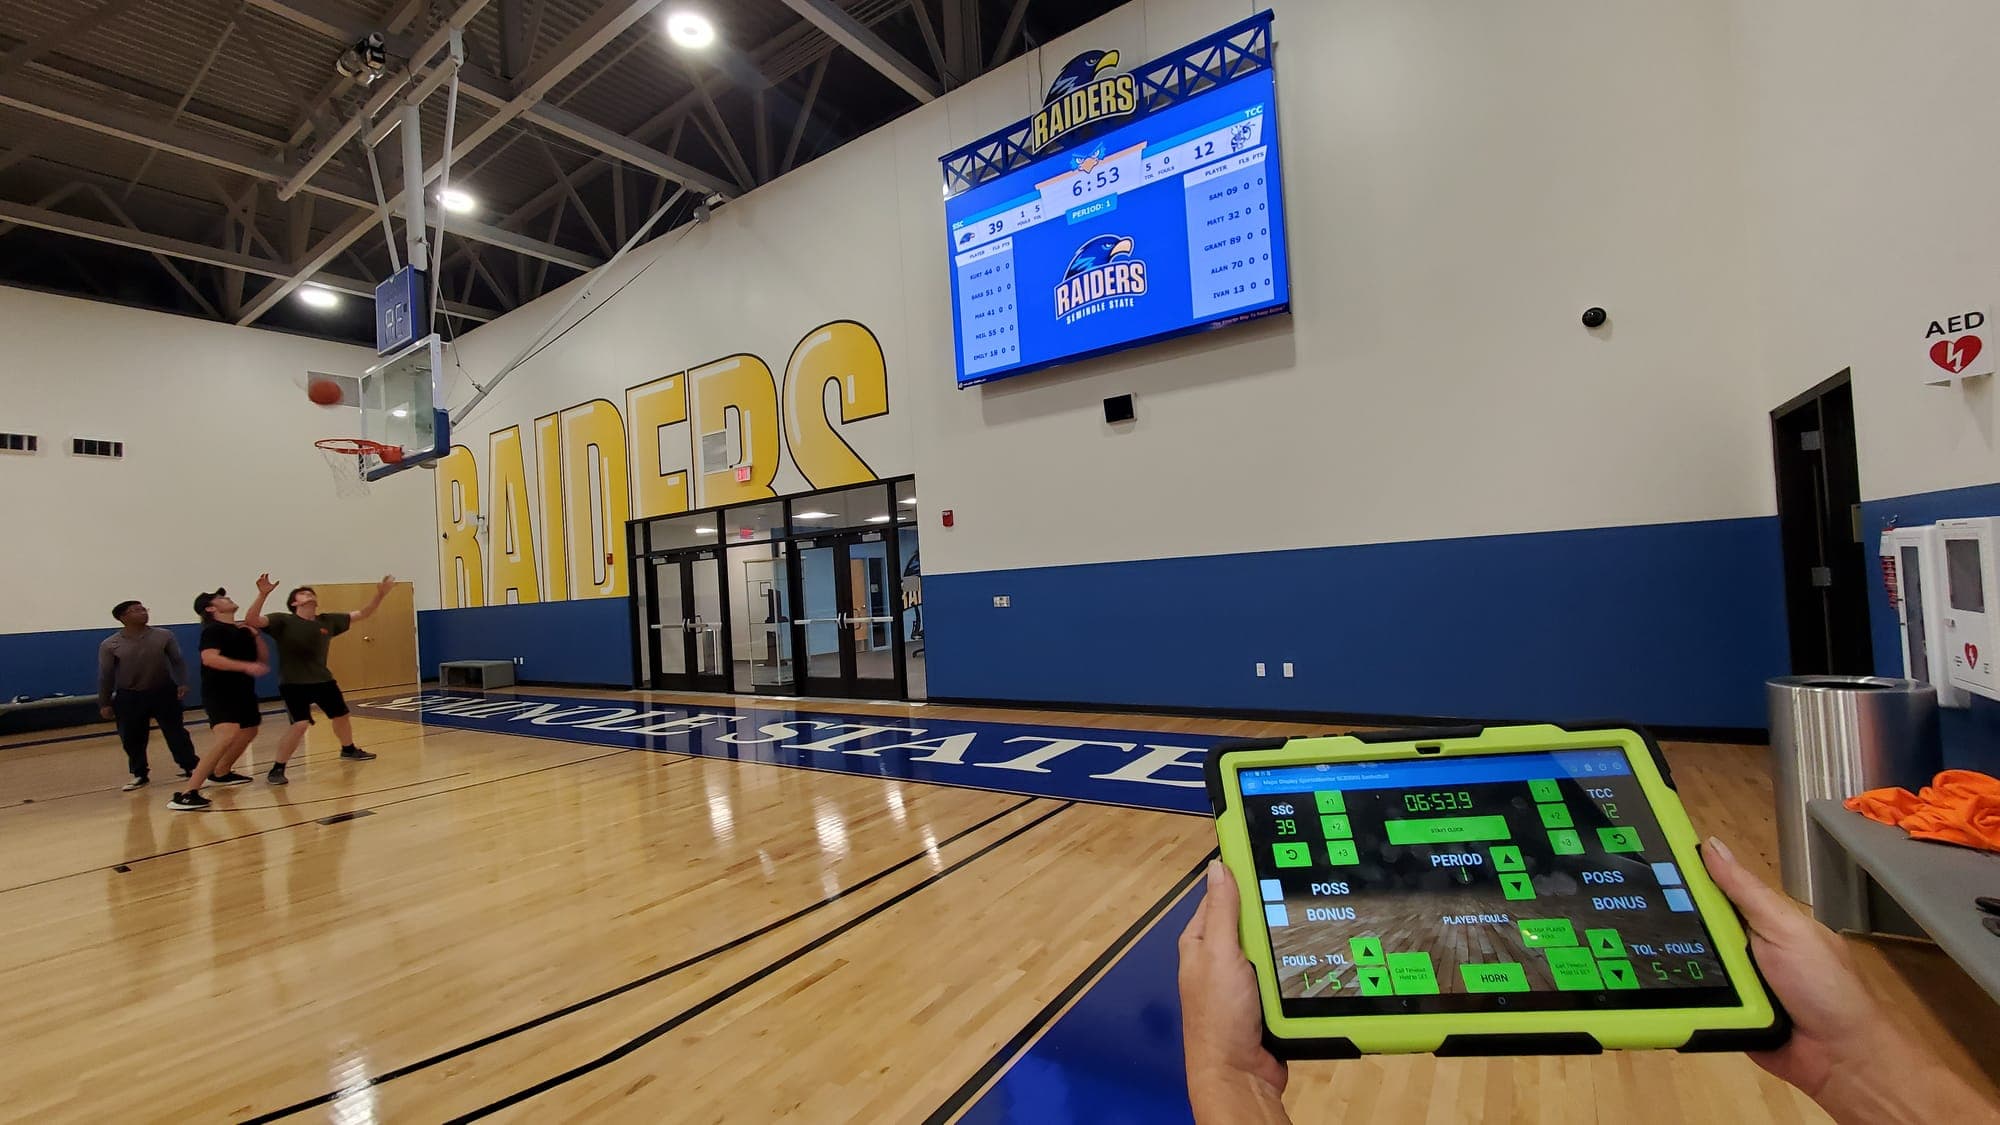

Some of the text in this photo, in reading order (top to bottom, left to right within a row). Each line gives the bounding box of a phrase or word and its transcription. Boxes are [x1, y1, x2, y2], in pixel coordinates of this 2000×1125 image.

[1033, 76, 1134, 150] RAIDERS
[1244, 106, 1263, 118] TCC
[1194, 142, 1214, 160] 12
[1252, 152, 1264, 160] PTS
[1146, 163, 1152, 172] 5
[1205, 165, 1228, 176] PLAYER
[1073, 167, 1120, 196] 6:53
[1209, 192, 1224, 200] SAM
[1226, 186, 1238, 196] 09
[1072, 202, 1104, 219] PERIOD:
[1207, 216, 1225, 226] MATT
[1228, 211, 1240, 220] 32
[1259, 202, 1265, 210] 0
[988, 220, 1003, 235] 39
[1204, 240, 1227, 252] GRANT
[1230, 236, 1241, 245] 89
[1211, 265, 1228, 274] ALAN
[1232, 260, 1243, 269] 70
[1056, 262, 1146, 316] RAIDERS
[1213, 290, 1230, 299] IVAN
[1234, 285, 1244, 294] 13
[1110, 298, 1134, 309] STATE
[1925, 312, 1984, 338] AED
[435, 319, 889, 609] RAIDERS
[357, 694, 1208, 789] SEMINOLE STATE
[1586, 788, 1614, 799] TCC
[1404, 792, 1473, 812] 06:53.9
[1270, 805, 1294, 815] SSC
[1602, 803, 1619, 818] 12
[1275, 819, 1296, 835] 39
[1430, 853, 1483, 867] PERIOD
[1462, 866, 1468, 882] 1
[1582, 871, 1625, 884] POSS
[1312, 883, 1350, 896] POSS
[1592, 896, 1648, 910] BONUS
[1306, 907, 1356, 921] BONUS
[1443, 914, 1510, 925] PLAYER FOULS
[1630, 944, 1657, 956] TOL
[1665, 943, 1705, 954] FOULS
[1282, 955, 1317, 967] FOULS
[1326, 954, 1349, 965] TOL
[1652, 962, 1668, 980] 5
[1687, 961, 1704, 980] 0
[1328, 972, 1342, 990] 5
[1481, 974, 1509, 983] HORN
